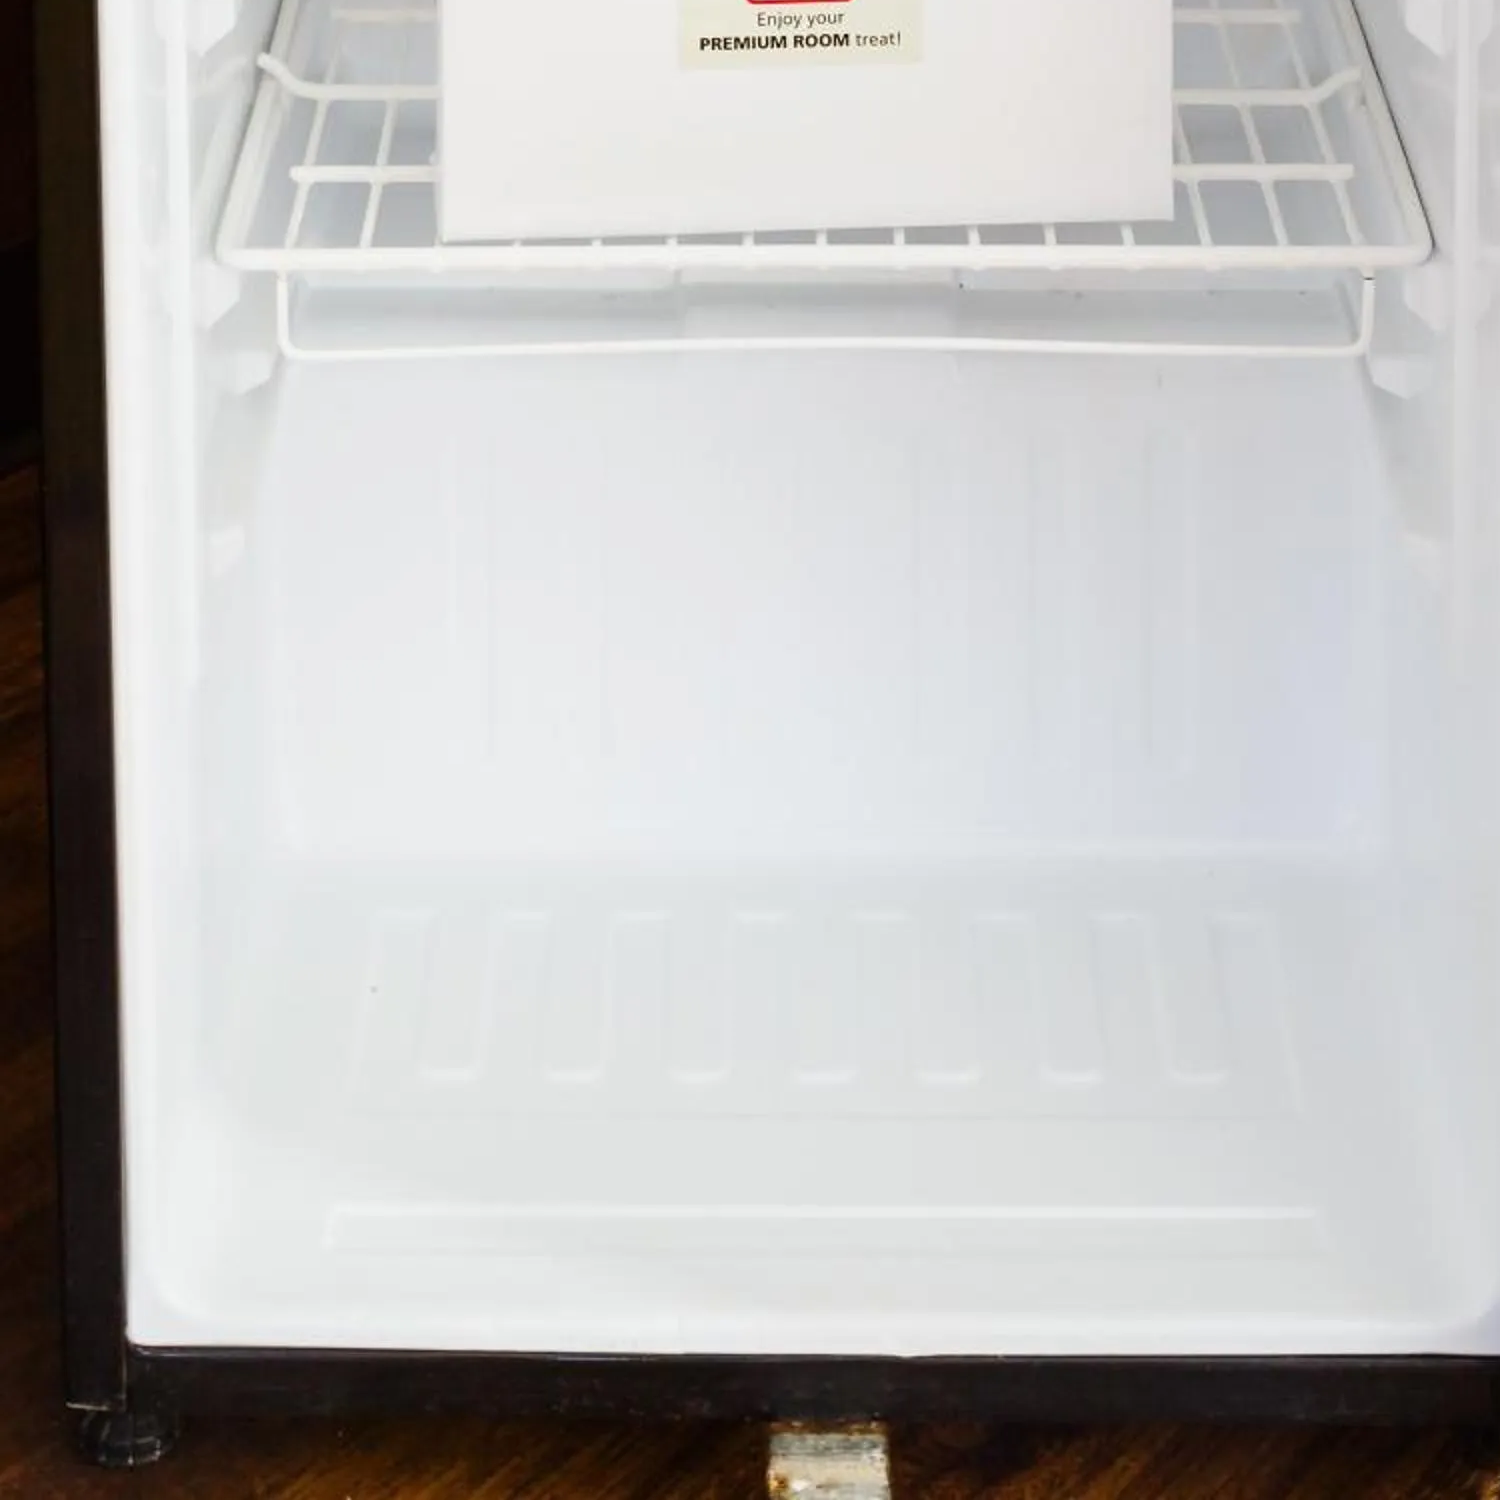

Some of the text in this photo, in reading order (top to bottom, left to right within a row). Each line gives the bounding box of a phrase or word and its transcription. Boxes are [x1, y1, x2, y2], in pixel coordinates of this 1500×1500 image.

[757, 12, 845, 29] Enjoy your
[700, 32, 902, 51] PREMIUM ROOM treat!
